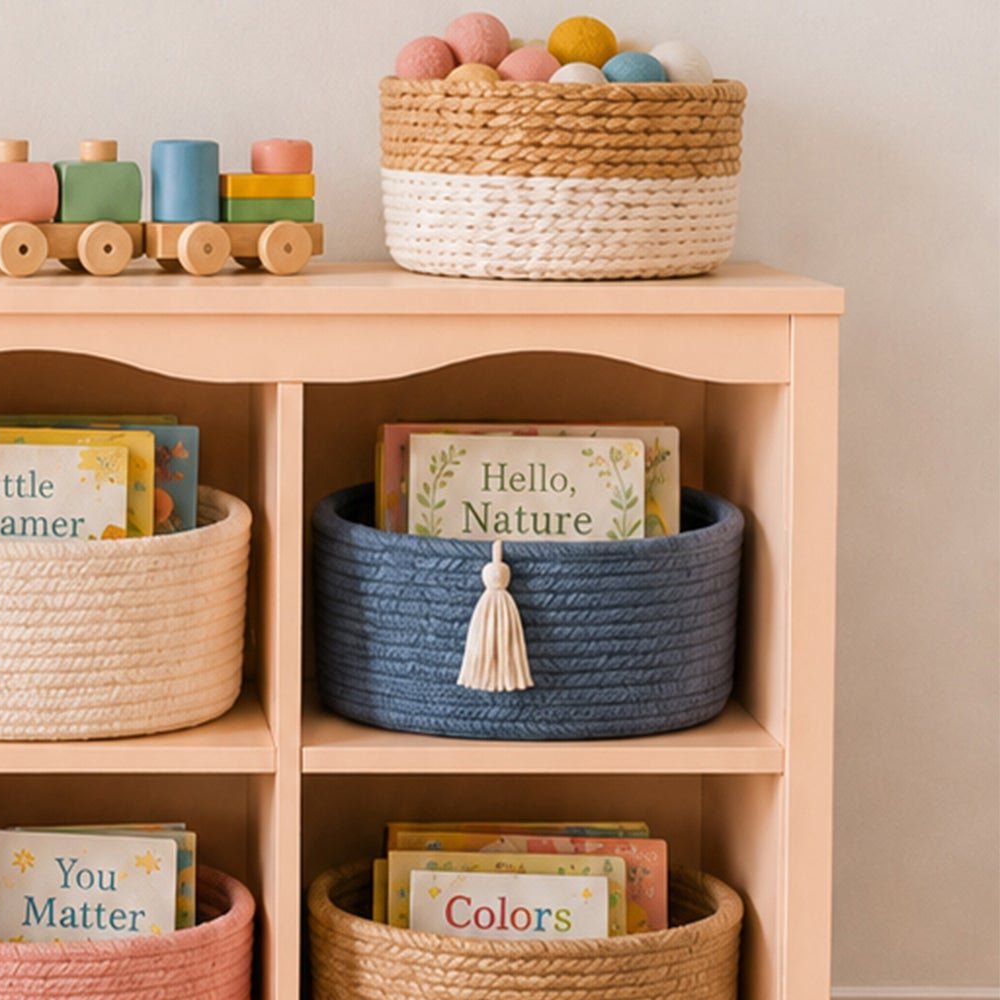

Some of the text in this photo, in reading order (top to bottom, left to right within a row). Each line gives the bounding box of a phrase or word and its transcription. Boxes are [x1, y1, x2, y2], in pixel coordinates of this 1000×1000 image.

[481, 462, 576, 498] Hello,
[462, 501, 593, 536] Nature
[55, 858, 117, 892] You
[21, 896, 146, 932] Matter
[444, 895, 572, 932] Colors
